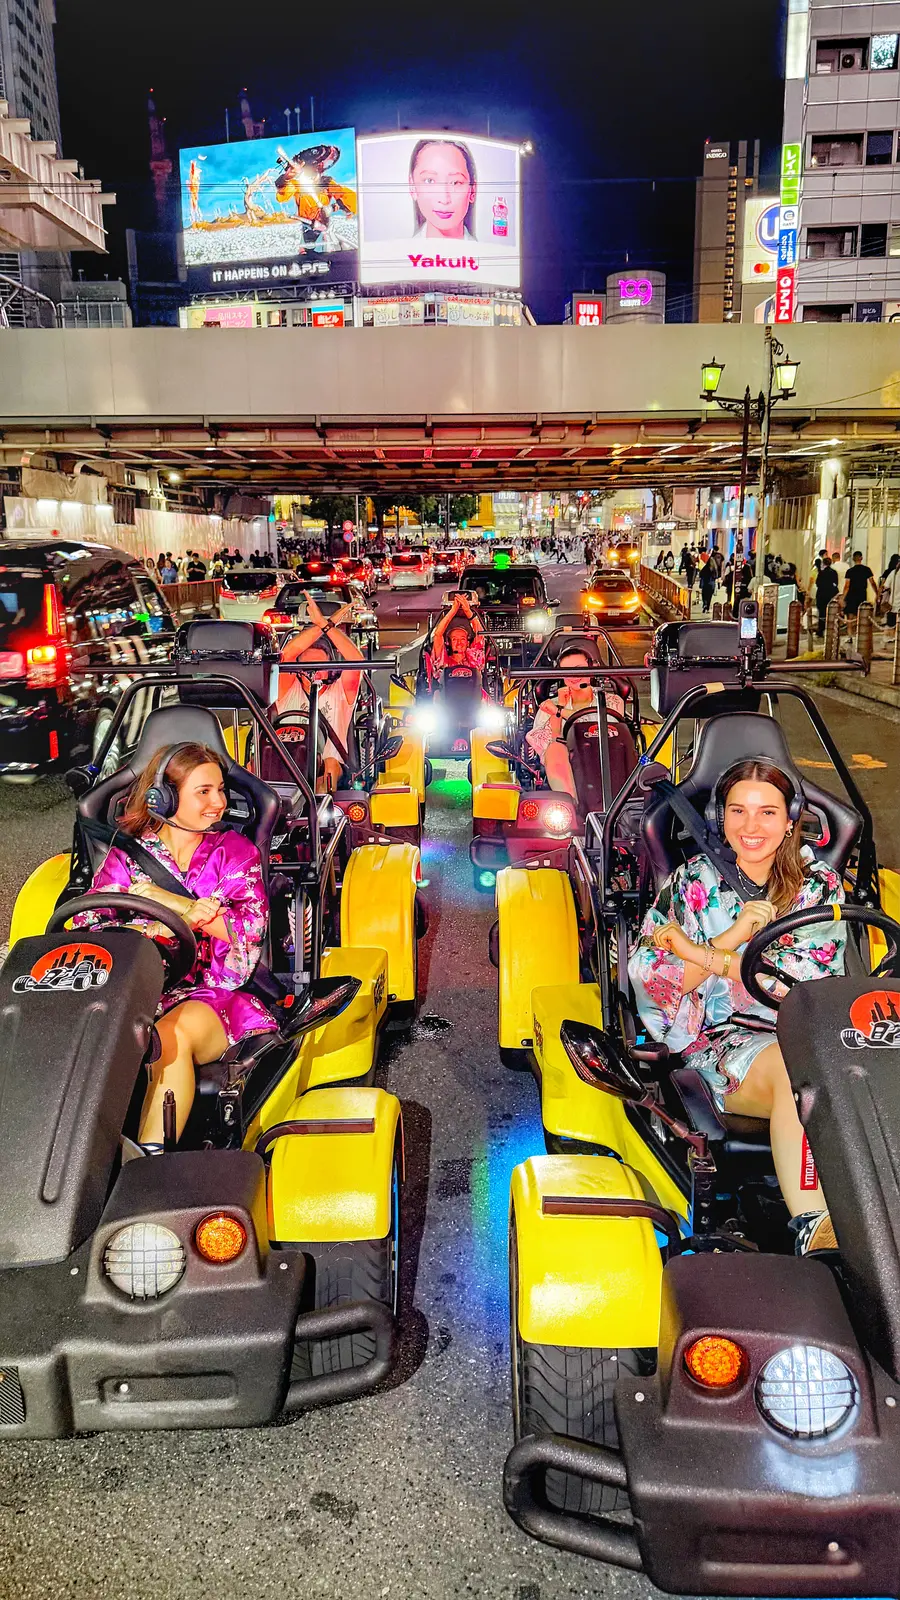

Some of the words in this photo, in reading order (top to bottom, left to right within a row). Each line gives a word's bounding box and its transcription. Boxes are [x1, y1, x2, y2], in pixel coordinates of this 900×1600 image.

[785, 149, 797, 180] レイク
[407, 254, 479, 271] Yakult
[212, 271, 222, 282] IT
[224, 267, 270, 281] HAPPENS
[272, 265, 287, 277] ON
[619, 279, 652, 305] 109
[578, 303, 599, 315] UNI
[778, 288, 791, 320] アコム
